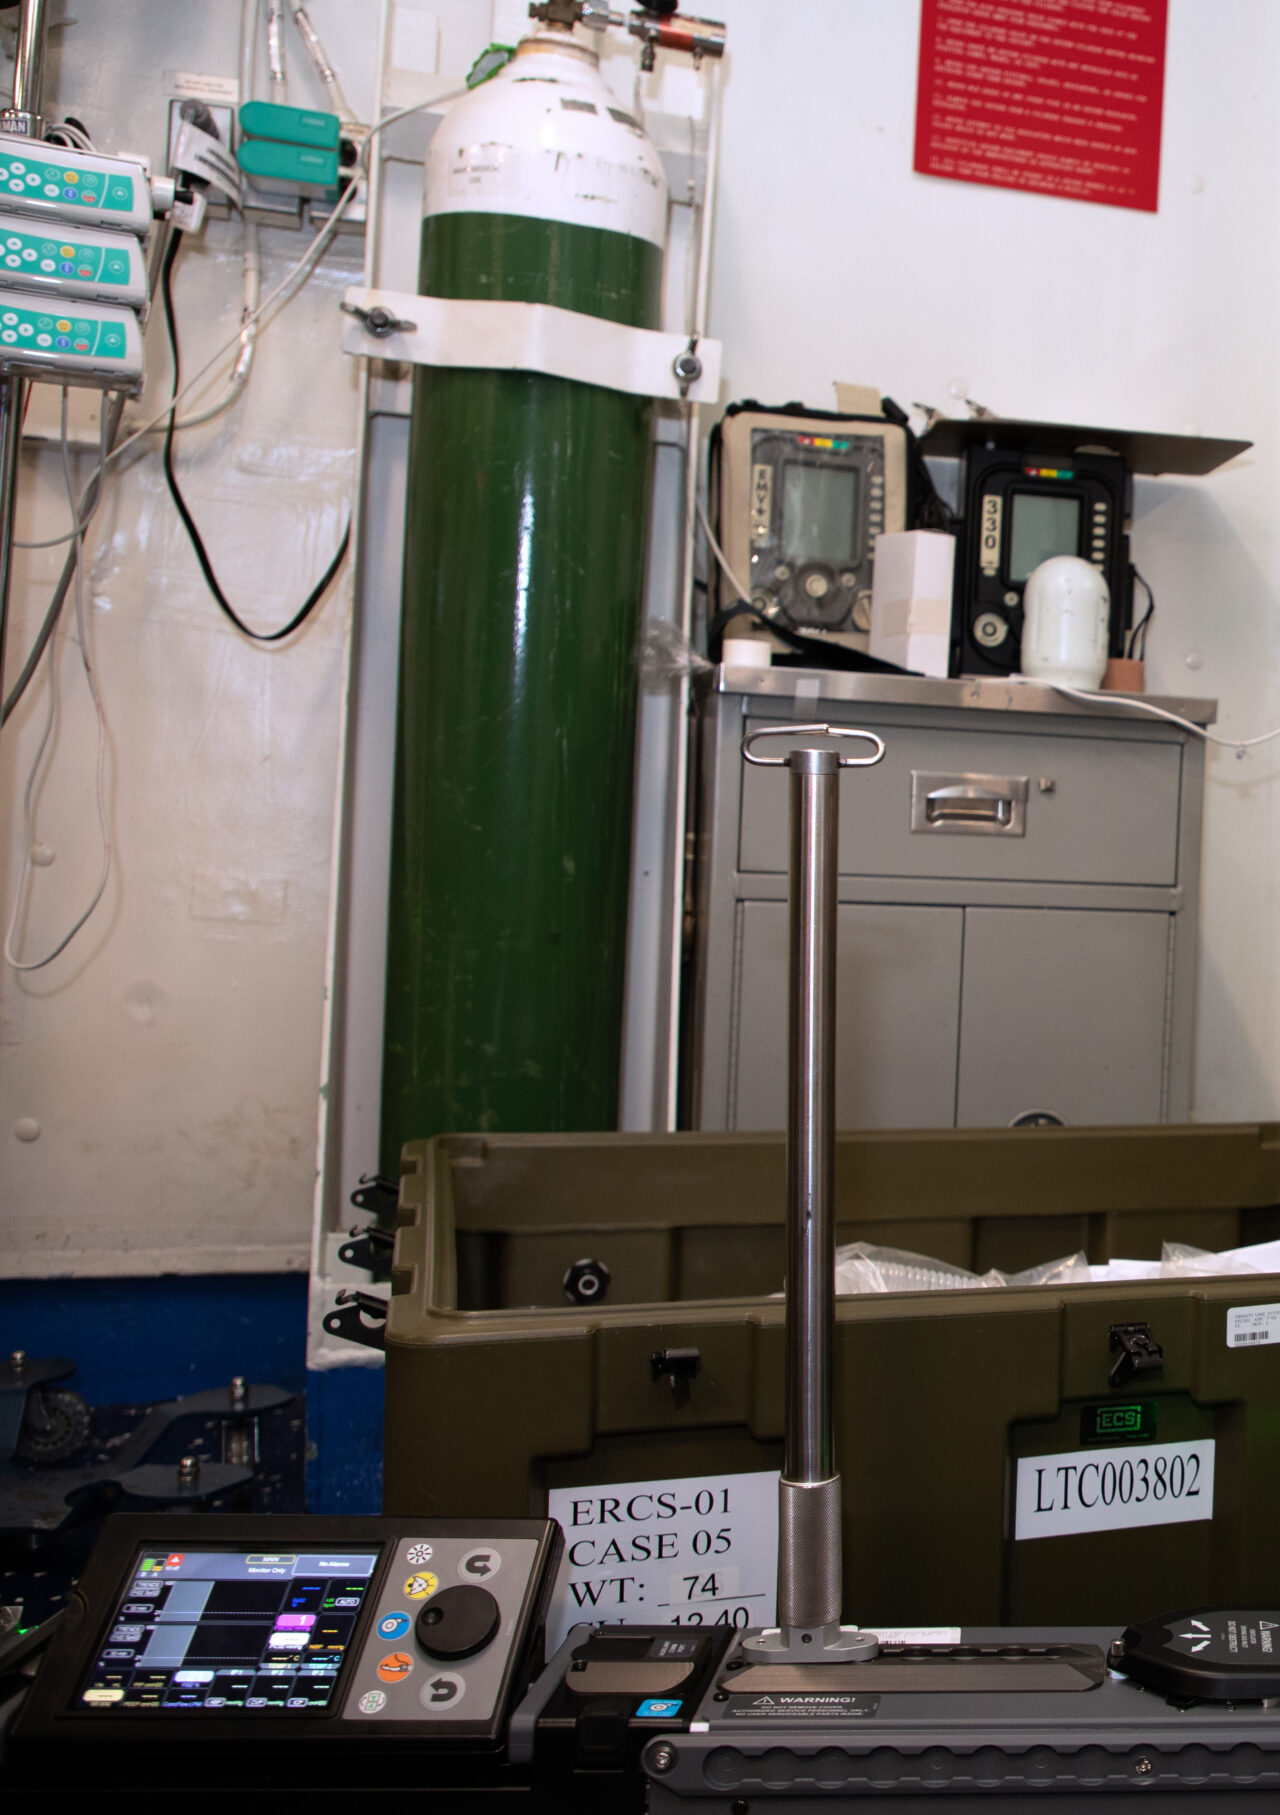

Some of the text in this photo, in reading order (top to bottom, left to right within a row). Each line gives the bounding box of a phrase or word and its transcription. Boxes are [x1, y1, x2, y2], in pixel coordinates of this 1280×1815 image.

[985, 500, 997, 549] 330
[1102, 1411, 1136, 1428] ECS
[1033, 1453, 1200, 1513] LTC003802
[570, 1488, 732, 1527] ERCS-01
[568, 1528, 732, 1567] CASE 05
[568, 1573, 720, 1608] WT: 74
[1260, 1630, 1273, 1653] WARNING!
[780, 1696, 856, 1704] WARNING!
